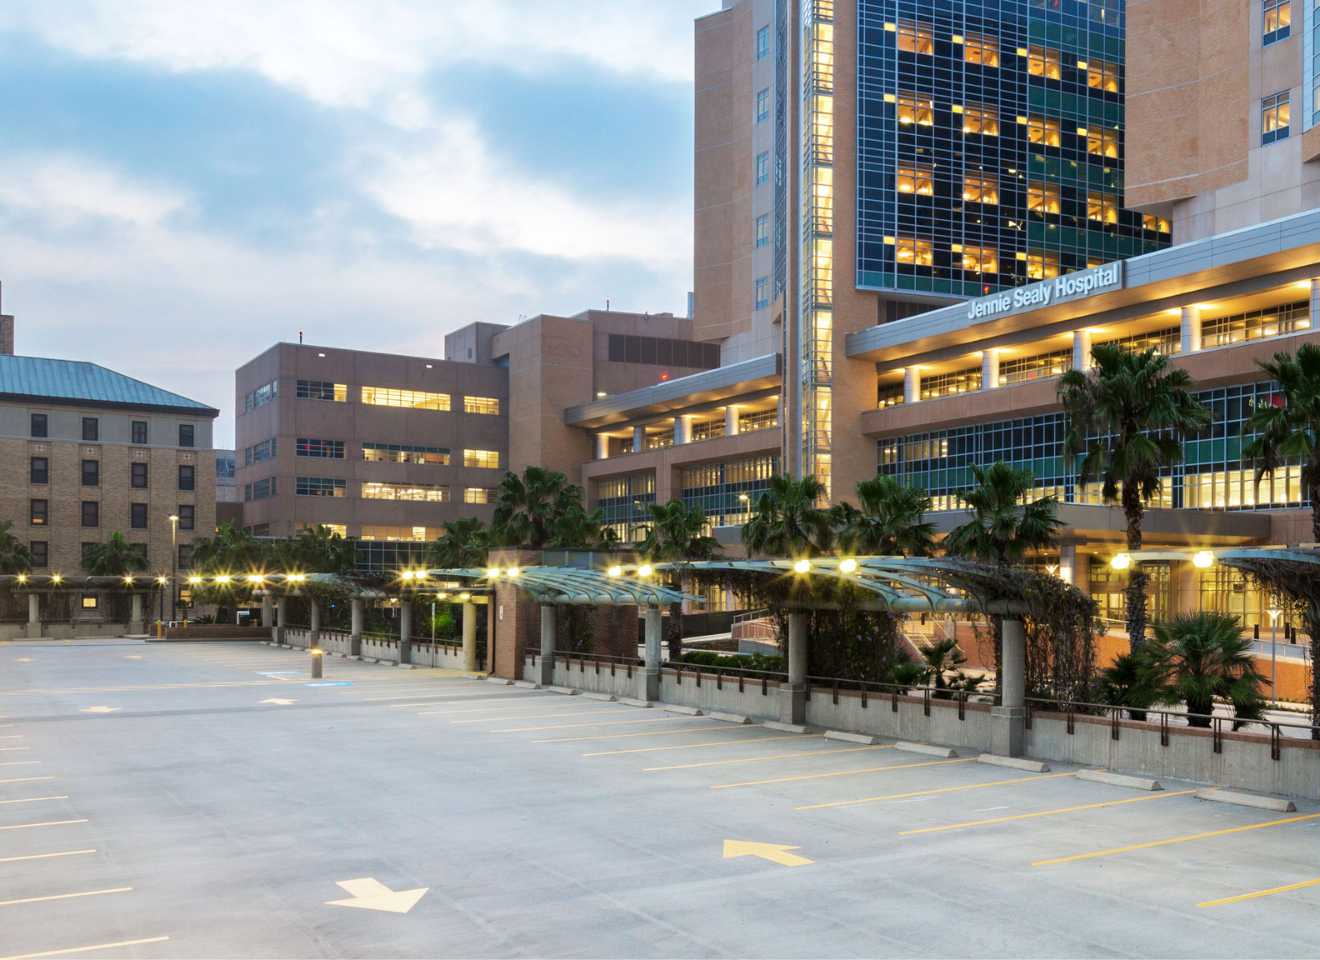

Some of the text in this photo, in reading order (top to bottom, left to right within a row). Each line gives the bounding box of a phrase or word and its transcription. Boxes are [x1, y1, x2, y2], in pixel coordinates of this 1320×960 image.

[967, 264, 1118, 319] Jennie Sealy Hospital
